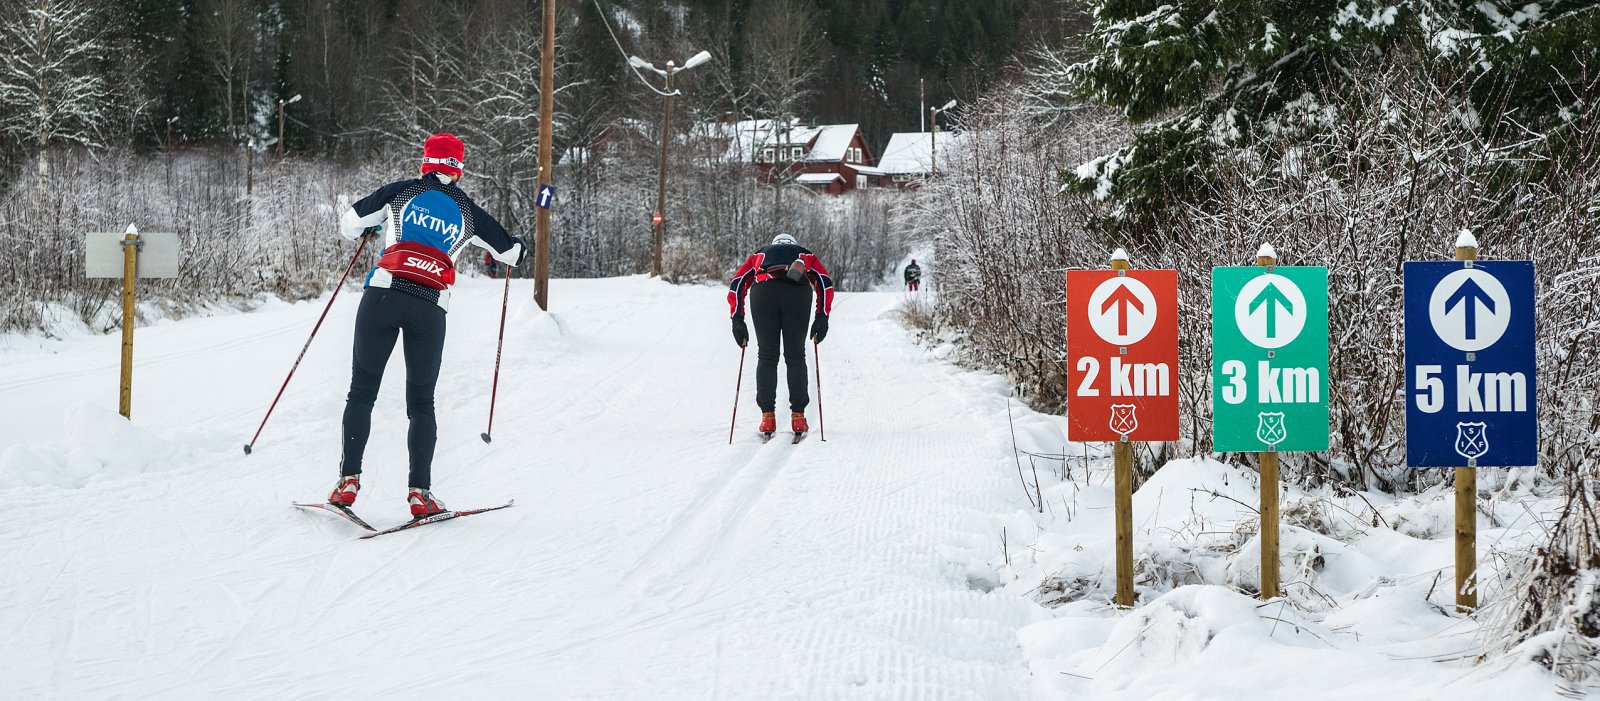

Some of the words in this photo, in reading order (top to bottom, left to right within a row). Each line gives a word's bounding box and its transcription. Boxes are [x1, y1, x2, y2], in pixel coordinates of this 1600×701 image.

[411, 203, 430, 214] team
[1077, 356, 1100, 397] 2
[1110, 356, 1170, 397] km
[1222, 359, 1247, 405] 3
[1258, 360, 1320, 404] km
[1415, 364, 1444, 414] 5
[1456, 364, 1527, 413] km
[1268, 416, 1275, 424] S
[1468, 427, 1475, 435] S
